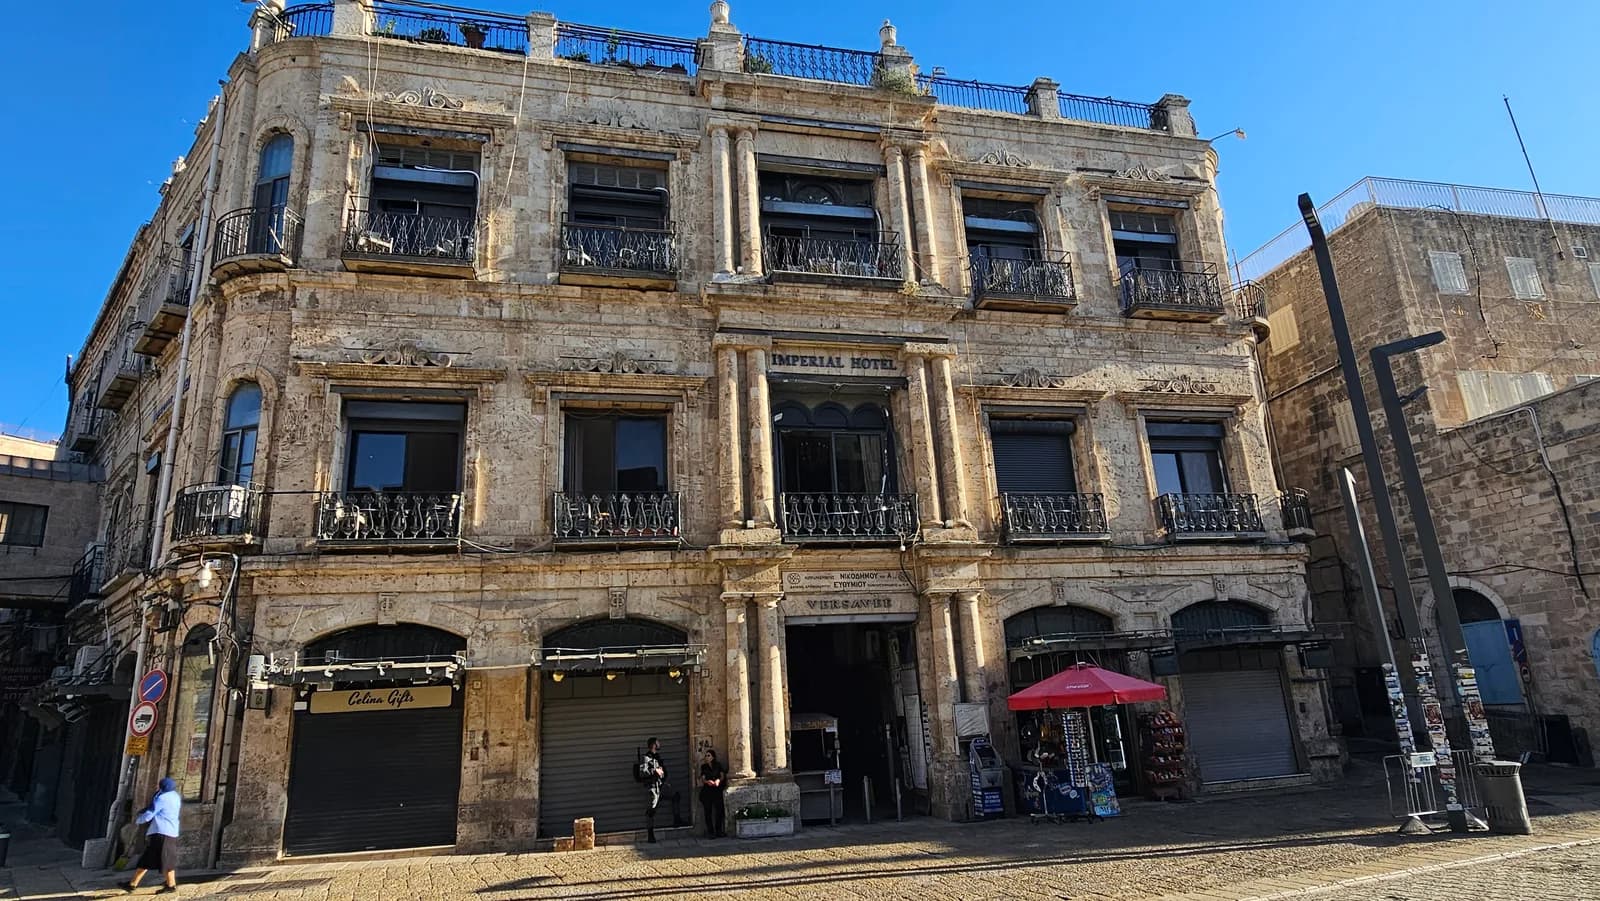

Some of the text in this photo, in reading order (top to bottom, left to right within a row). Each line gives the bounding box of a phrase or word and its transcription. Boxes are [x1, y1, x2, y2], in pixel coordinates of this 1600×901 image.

[771, 354, 897, 370] IMPERIAL HOTEL
[348, 689, 415, 707] Celina Gifts
